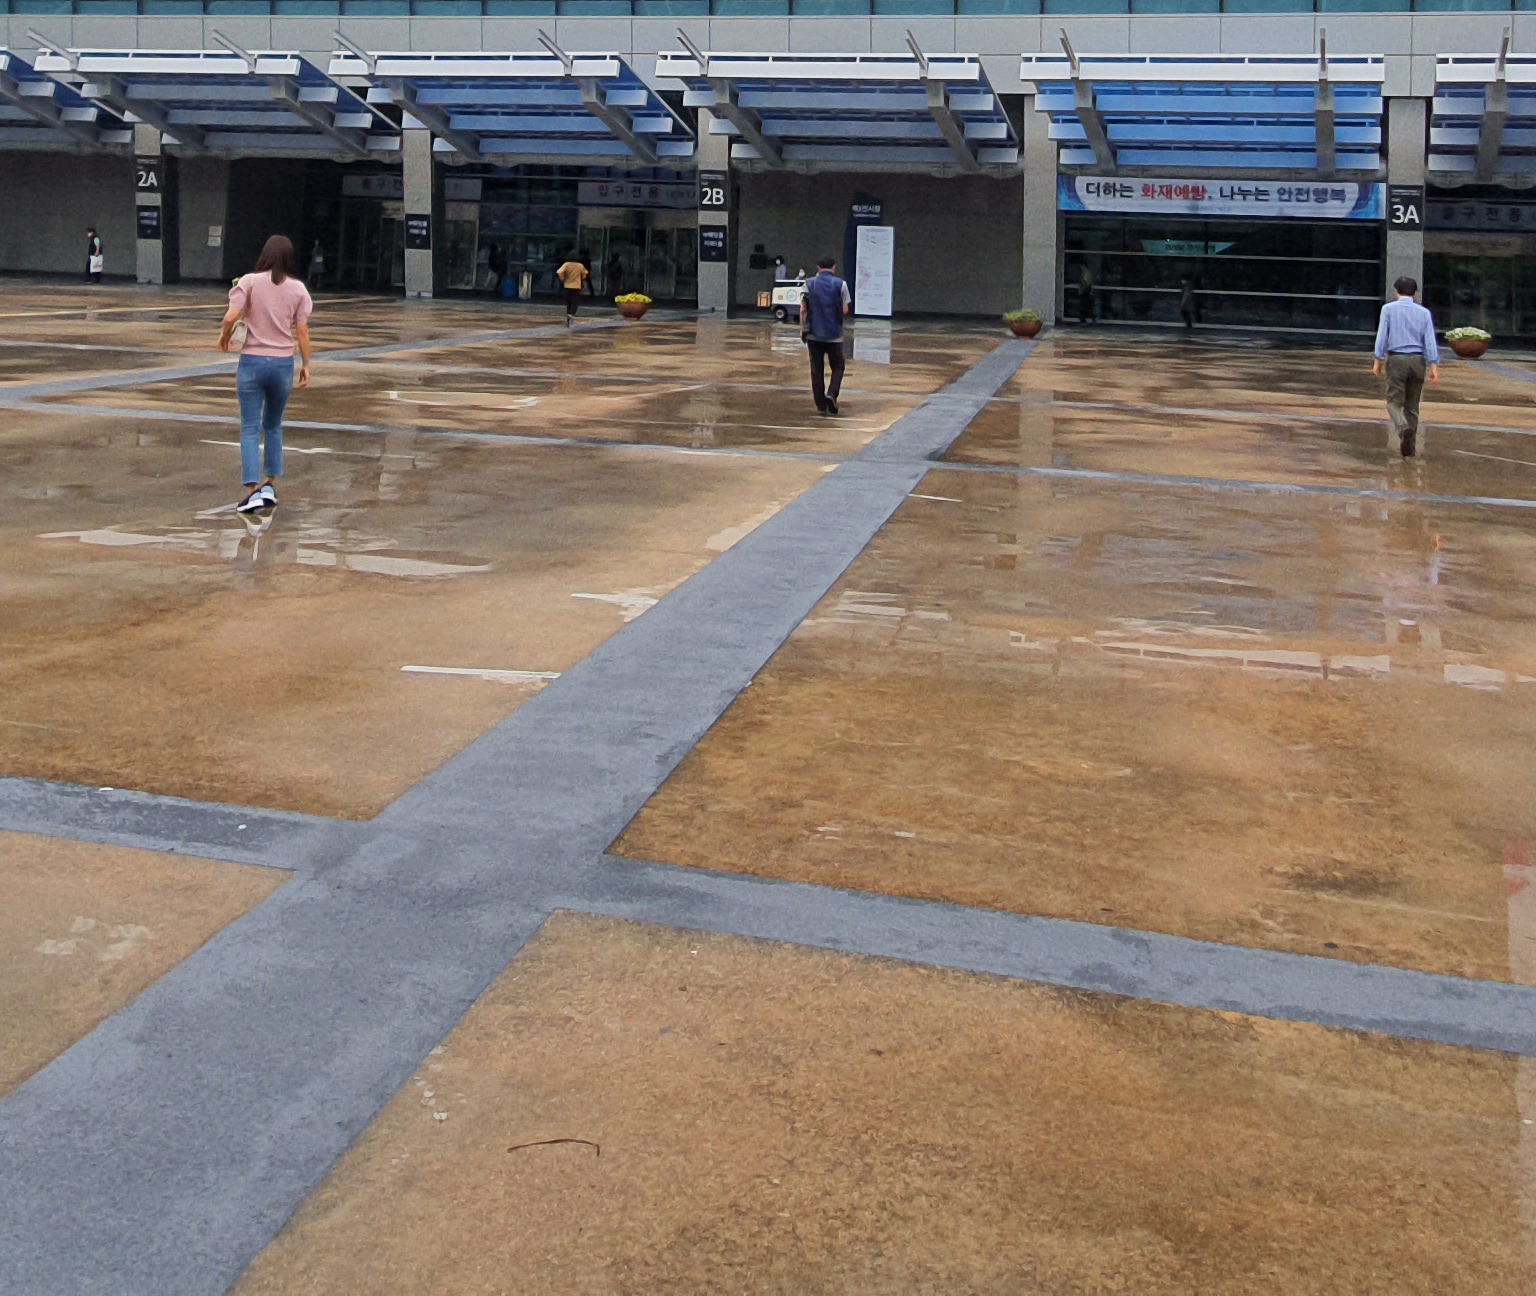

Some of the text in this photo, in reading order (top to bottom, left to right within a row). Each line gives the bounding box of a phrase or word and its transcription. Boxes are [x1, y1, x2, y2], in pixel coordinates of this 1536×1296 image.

[137, 171, 158, 187] 2A
[701, 187, 724, 205] 2B
[1085, 182, 1134, 199] 더하는
[1219, 186, 1270, 201] 나누는
[1277, 187, 1346, 203] 안전행복
[1391, 204, 1419, 224] 3A
